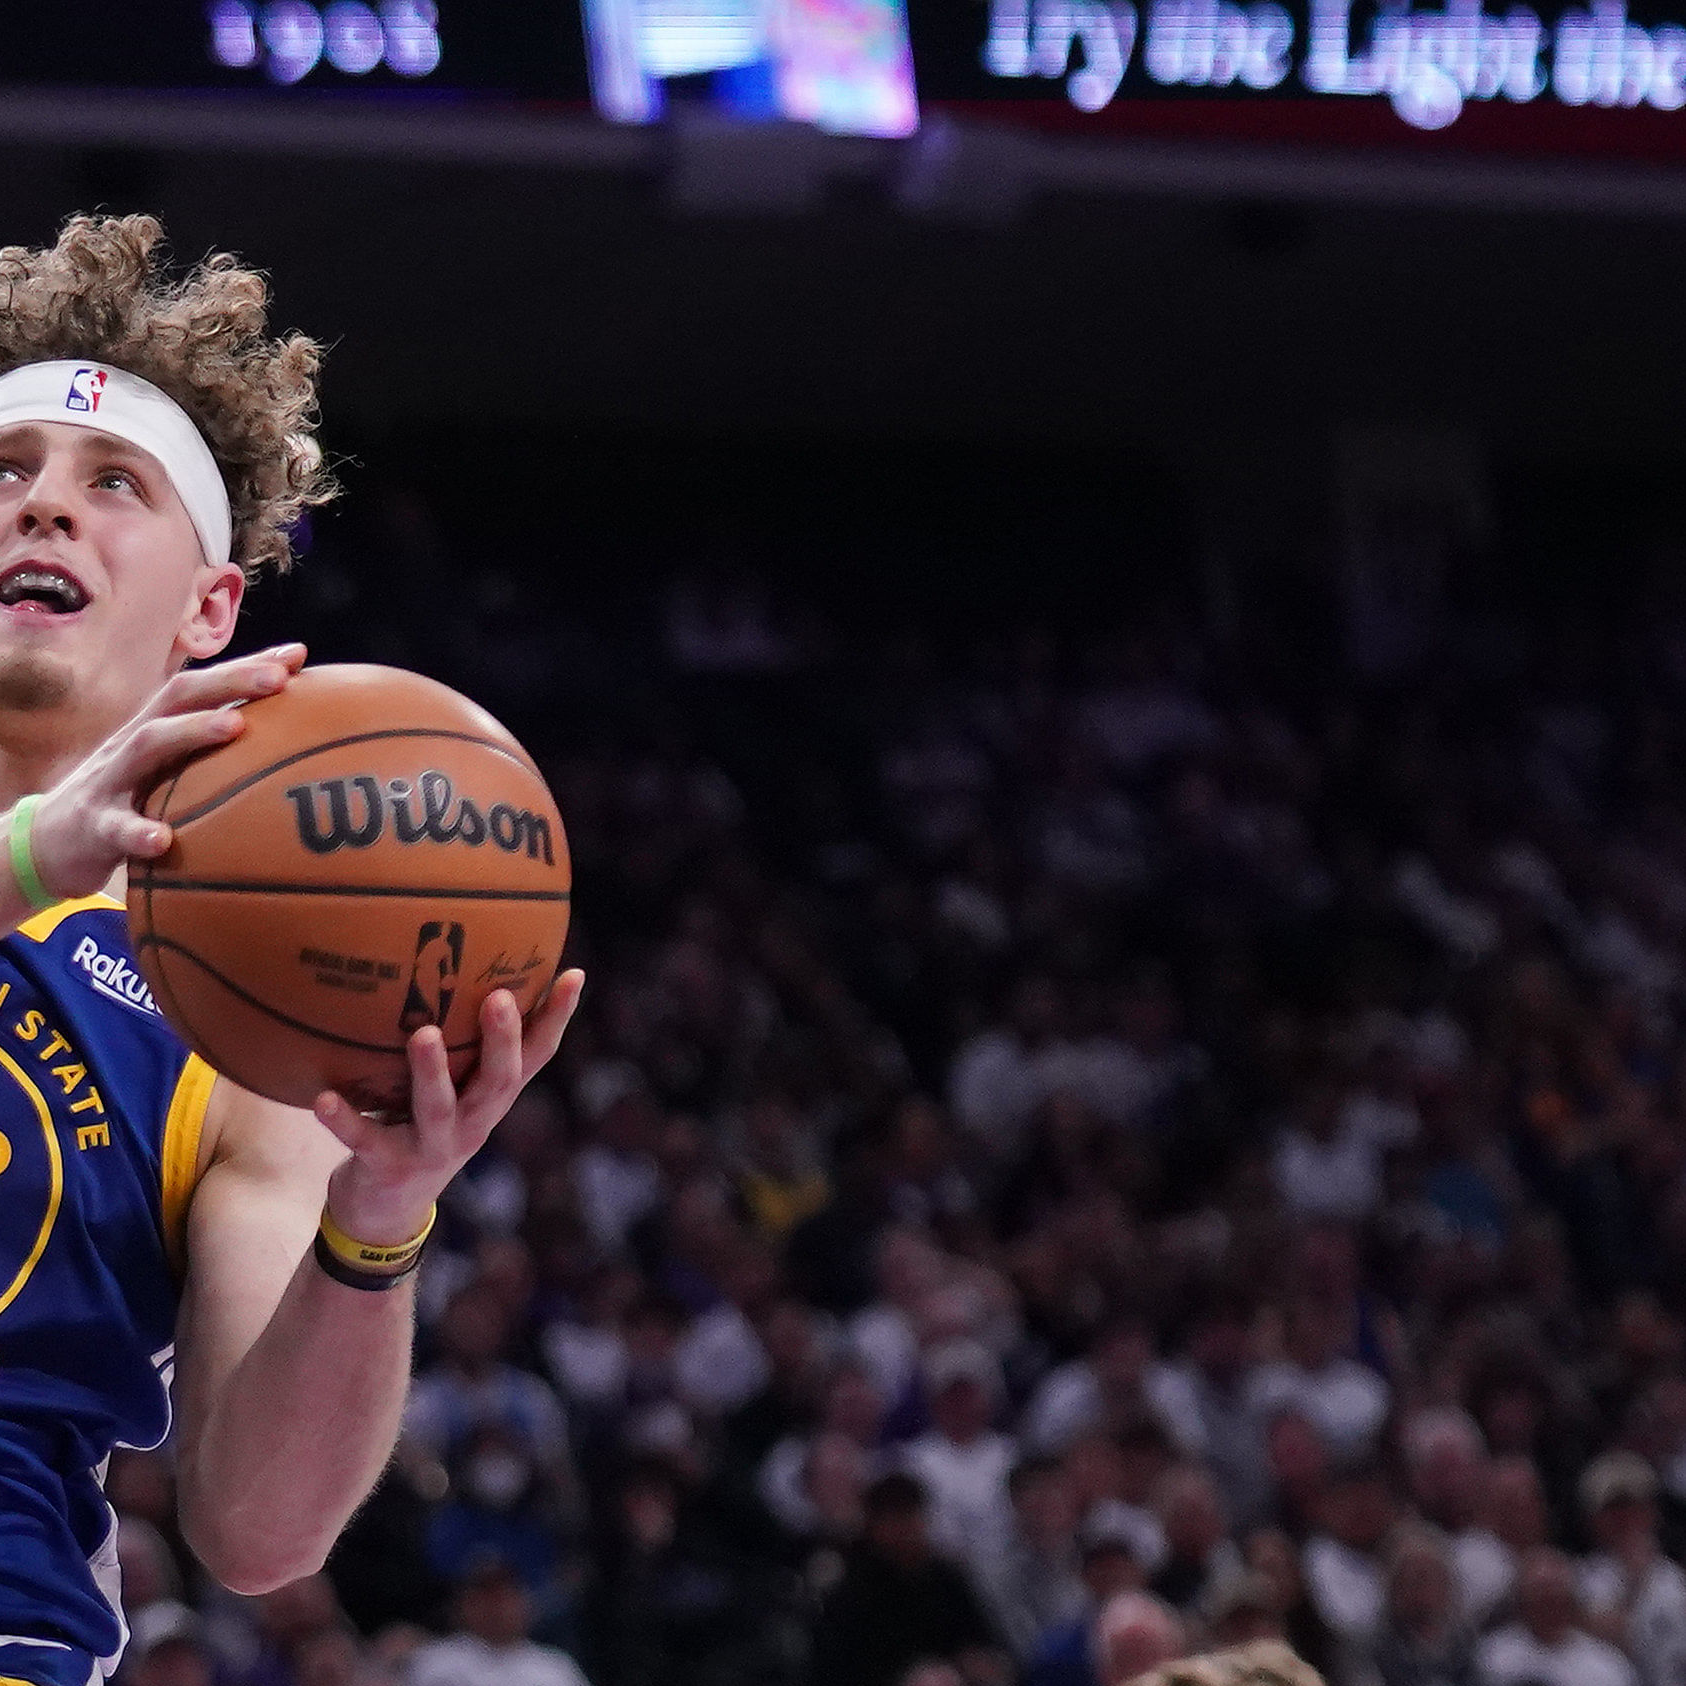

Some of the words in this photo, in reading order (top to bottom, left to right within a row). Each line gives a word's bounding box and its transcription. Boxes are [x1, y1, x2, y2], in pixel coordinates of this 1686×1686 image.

[1144, 0, 1294, 89] the
[1302, 0, 1548, 131] Light
[285, 769, 555, 867] Wilson
[14, 1009, 111, 1151] STATE
